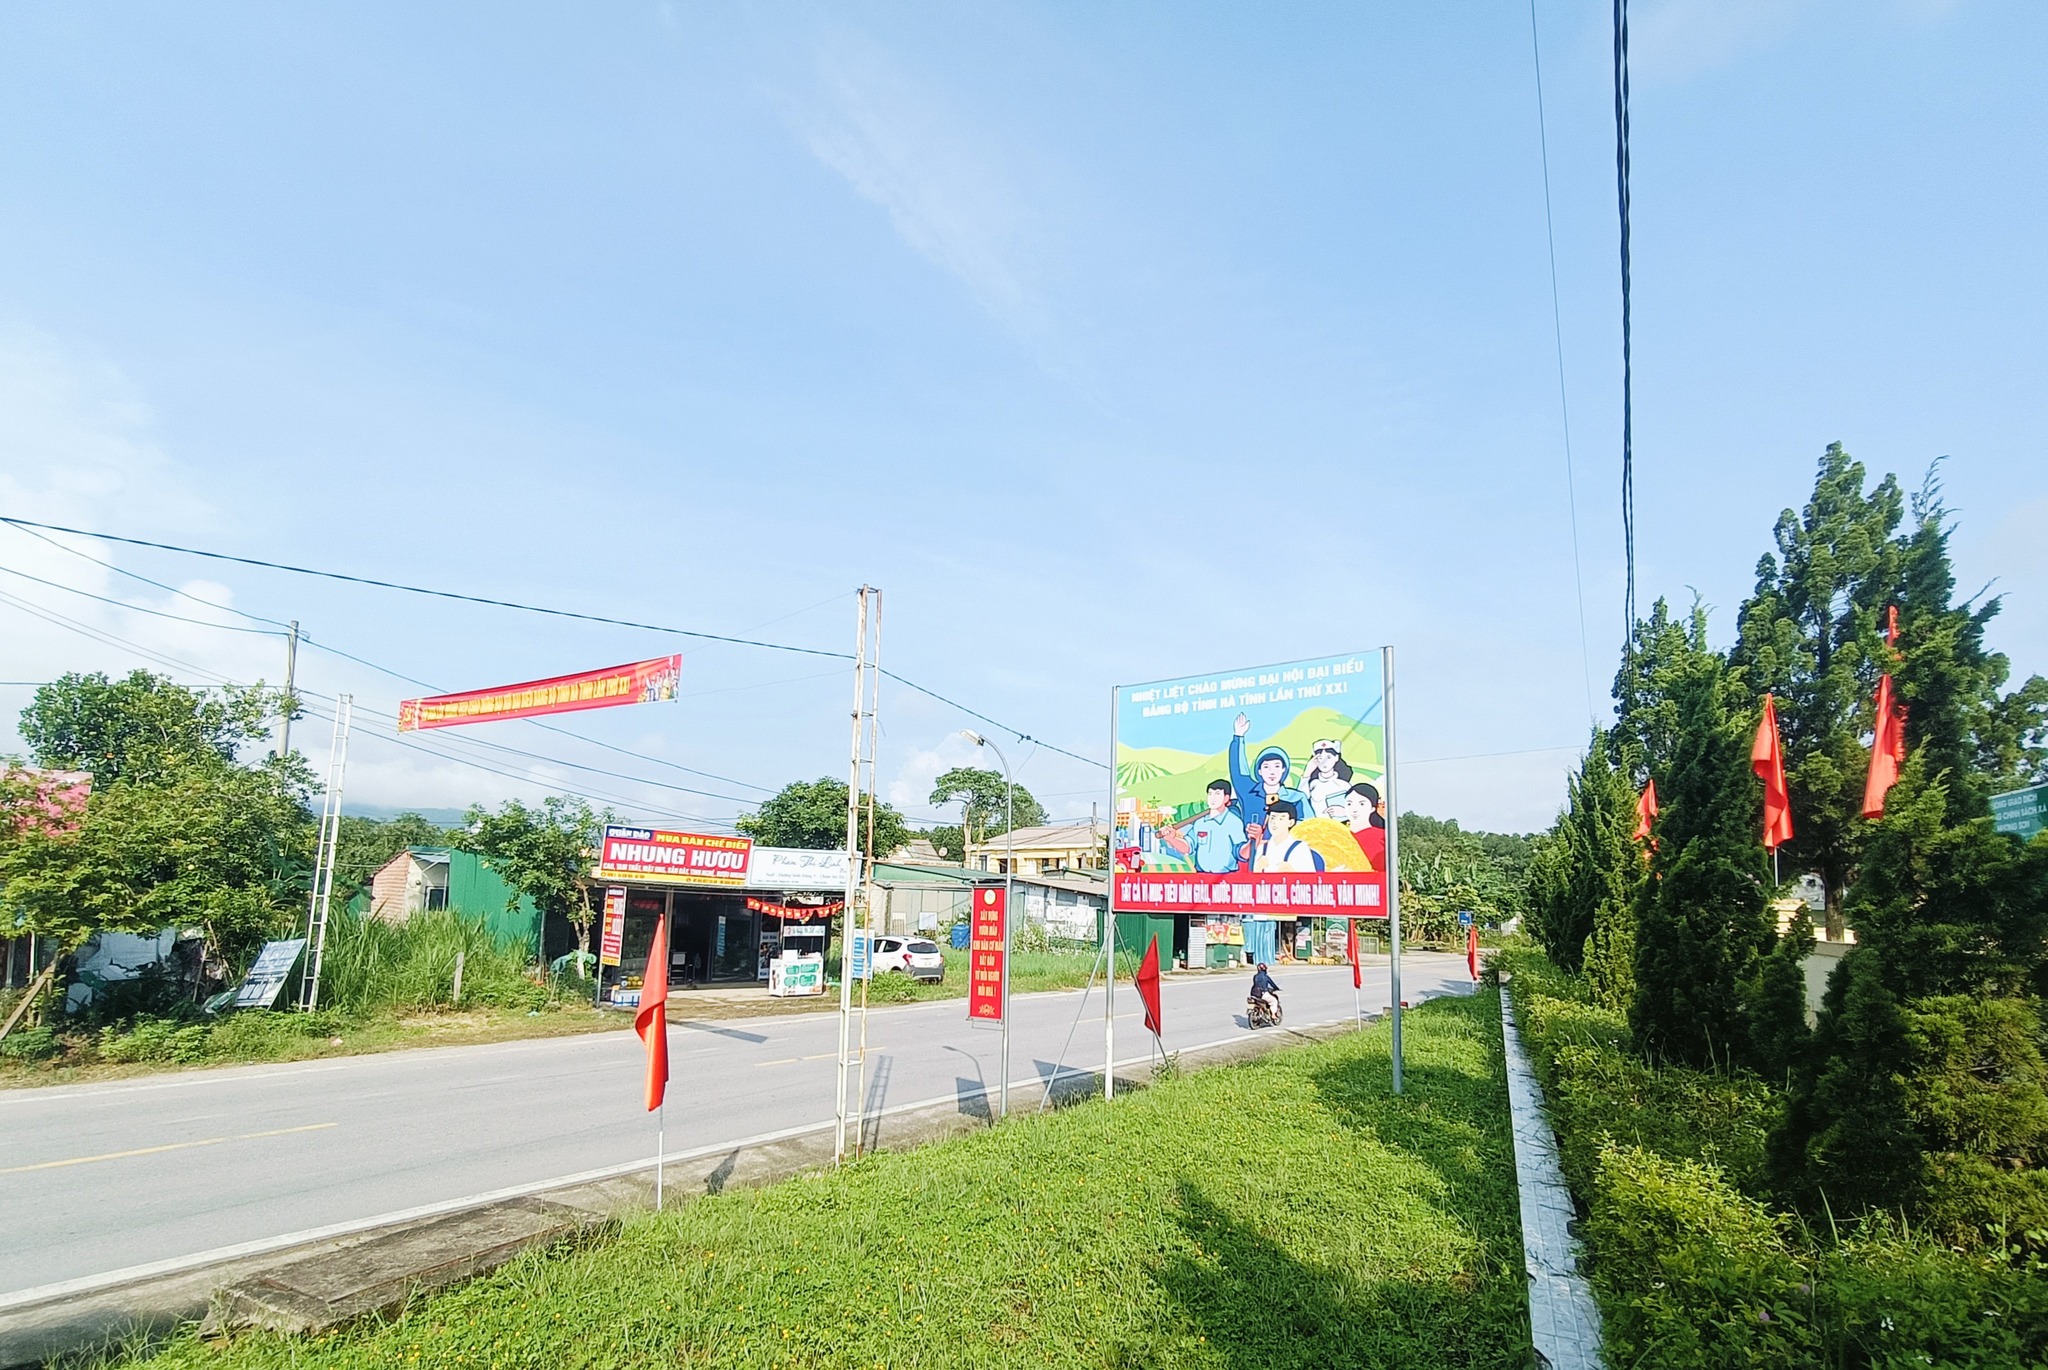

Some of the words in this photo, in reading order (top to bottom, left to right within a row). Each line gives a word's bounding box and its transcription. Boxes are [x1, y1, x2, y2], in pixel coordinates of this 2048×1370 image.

[1131, 688, 1162, 703] NHIỆT
[1163, 686, 1185, 700] LIỆT
[1187, 681, 1217, 695] CHÀO
[1220, 676, 1255, 691] MỪNG
[1259, 672, 1279, 687] ĐẠI
[1282, 667, 1303, 683] HỘI
[1307, 664, 1329, 679] ĐẠI
[1333, 658, 1364, 676] BIỂU
[1142, 703, 1171, 717] ĐẢNG
[1174, 701, 1189, 715] BỘ
[1219, 693, 1235, 709] HÀ
[1238, 691, 1266, 706] TĨNH
[1269, 686, 1293, 703] LẦN
[1297, 683, 1321, 699] THỨ
[610, 842, 686, 865] NHUNG
[691, 849, 745, 870] HƯƠU
[656, 834, 680, 844] MUA
[681, 835, 704, 846] BÁN
[705, 837, 725, 848] CHẾ
[725, 840, 748, 850] BIẾN
[1121, 876, 1132, 902] TẤT
[1132, 876, 1141, 902] CẢ
[1141, 878, 1148, 902] VÌ
[1148, 883, 1163, 906] MỤC
[1164, 879, 1178, 903] TIÊU
[1178, 879, 1192, 904] DÂN
[1193, 879, 1211, 906] GIÀU,
[1212, 879, 1231, 904] NƯỚC
[1231, 883, 1255, 908] MẠNH,
[1255, 879, 1271, 905] DÂN
[1271, 876, 1289, 907] CHỦ,
[1290, 879, 1311, 905] CÔNG
[1312, 876, 1336, 908] BẰNG,
[1337, 879, 1354, 906] VĂN
